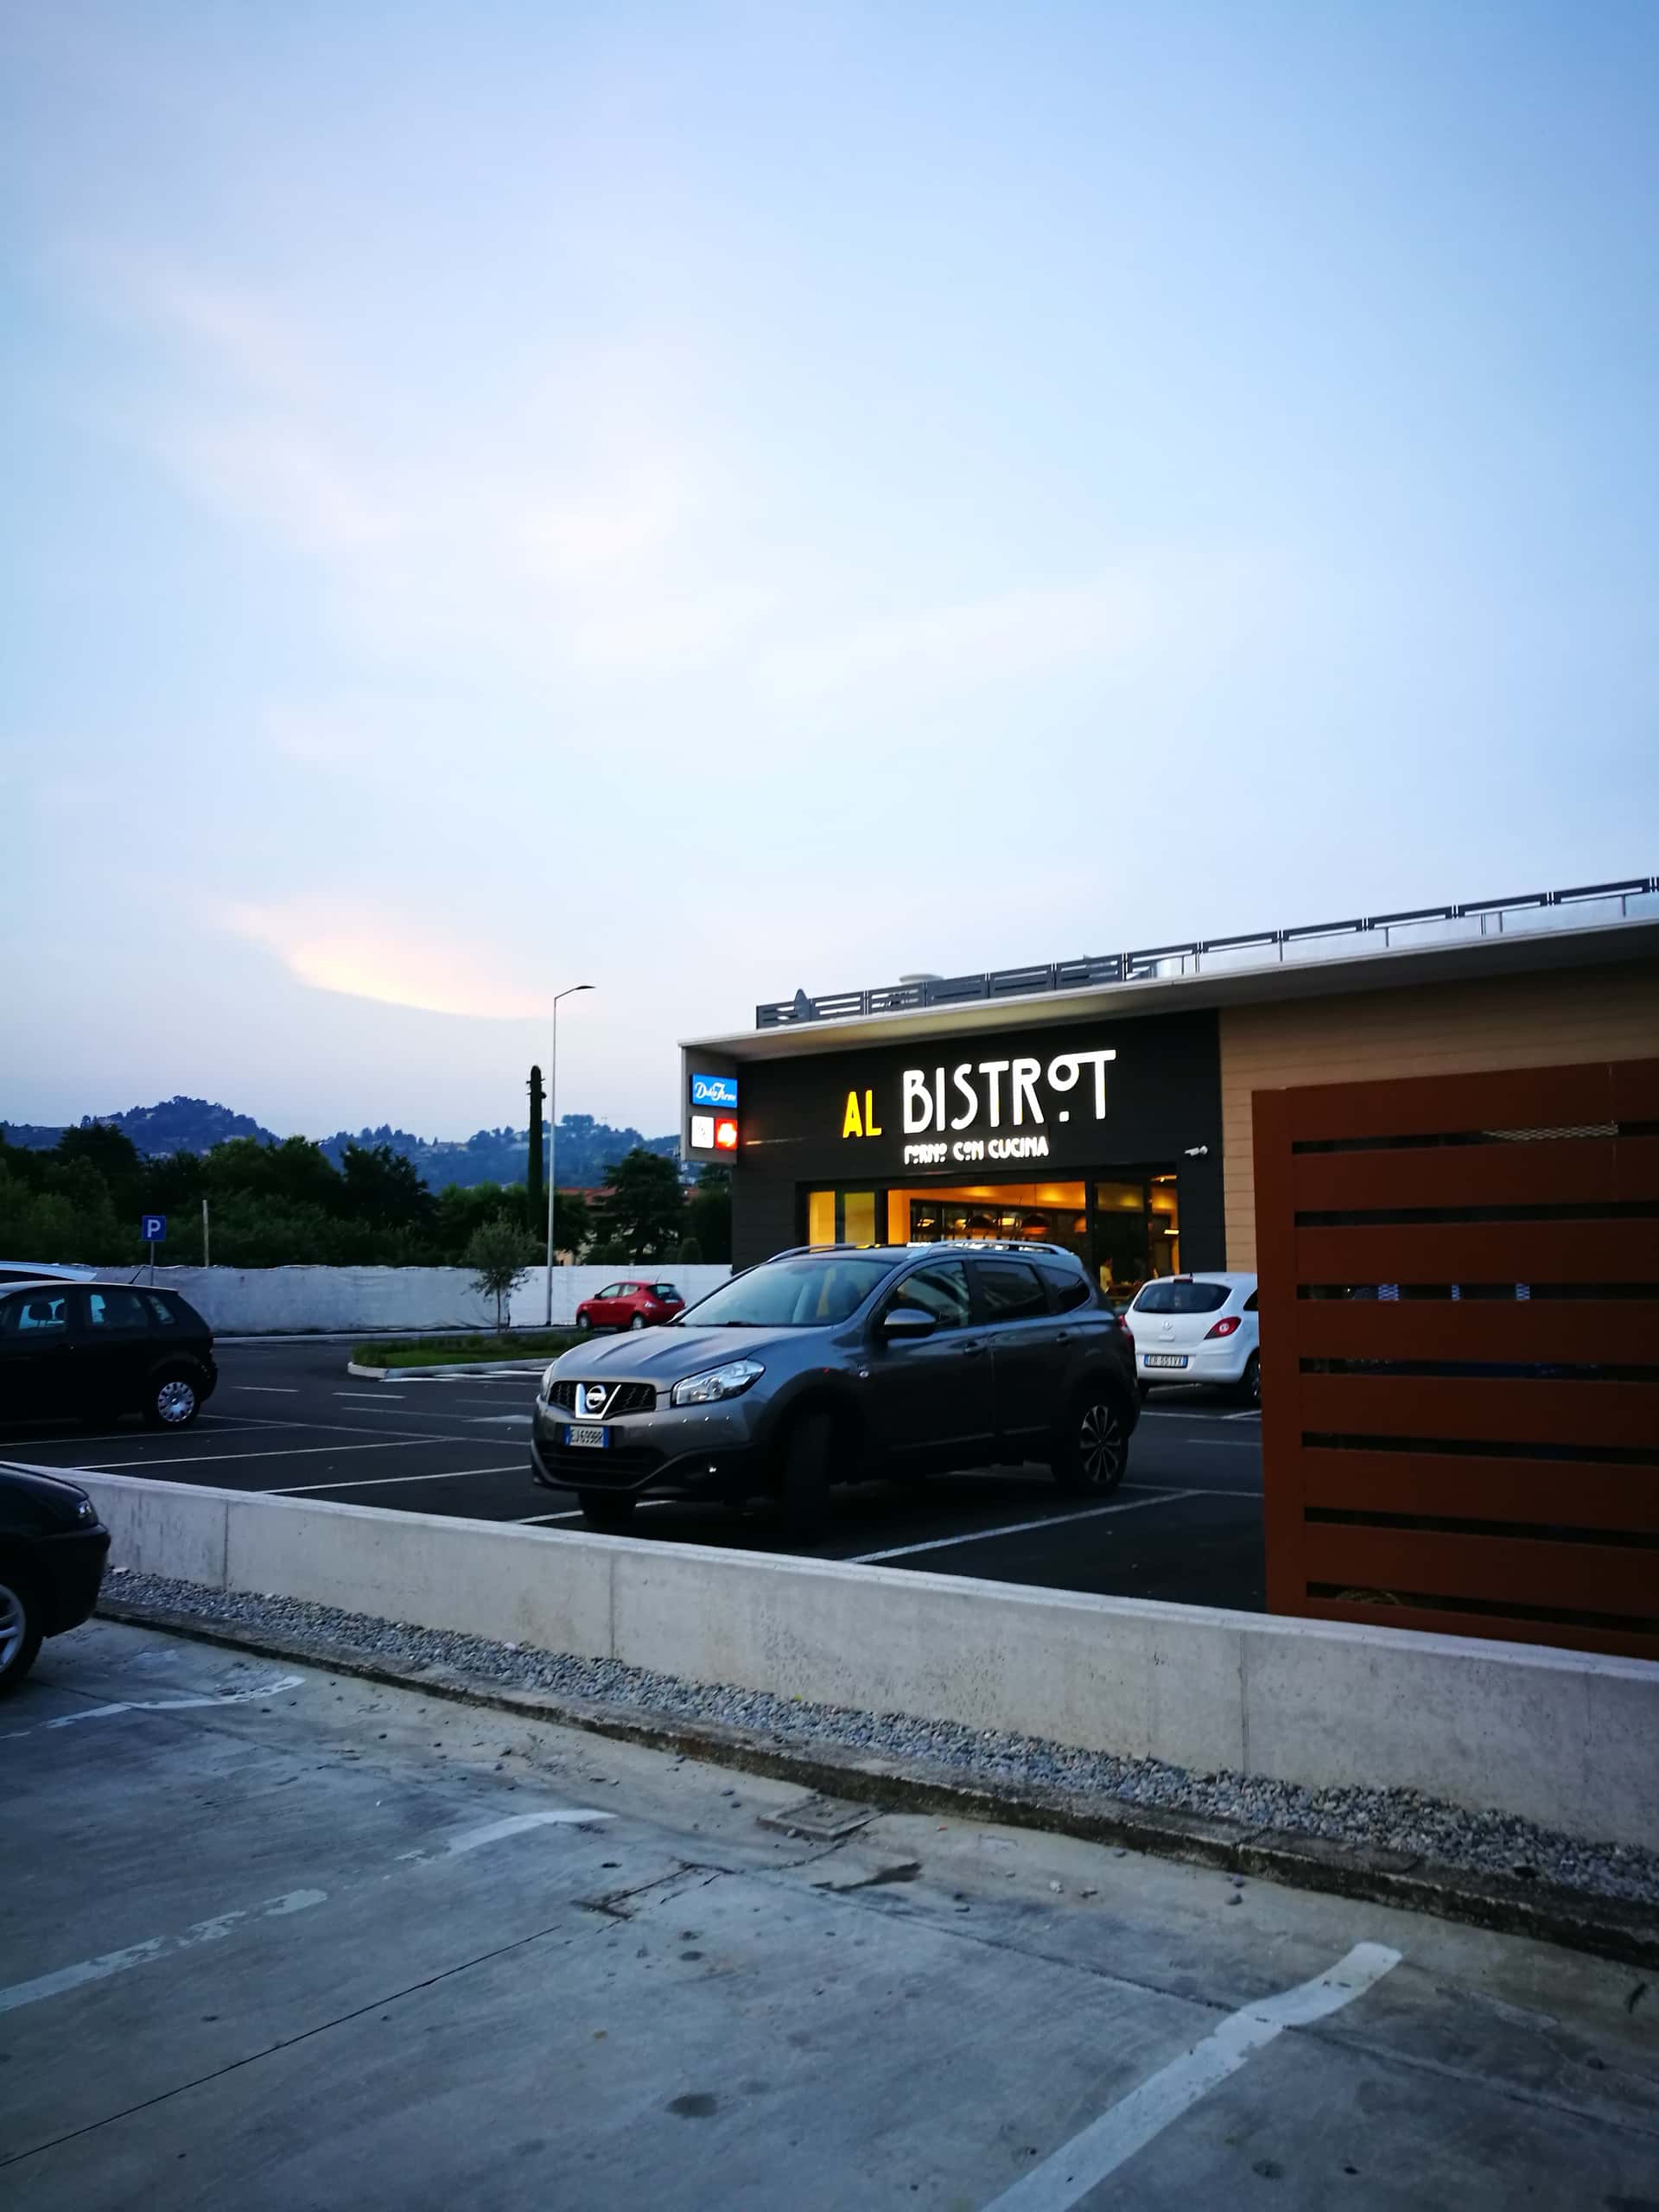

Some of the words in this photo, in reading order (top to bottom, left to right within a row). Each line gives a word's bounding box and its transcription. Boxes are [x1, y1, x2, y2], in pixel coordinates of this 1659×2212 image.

[842, 1090, 882, 1139] AL
[903, 1049, 1116, 1135] BISTROT
[952, 1140, 984, 1161] CON
[988, 1135, 1049, 1159] CUCINA
[147, 1219, 162, 1238] P
